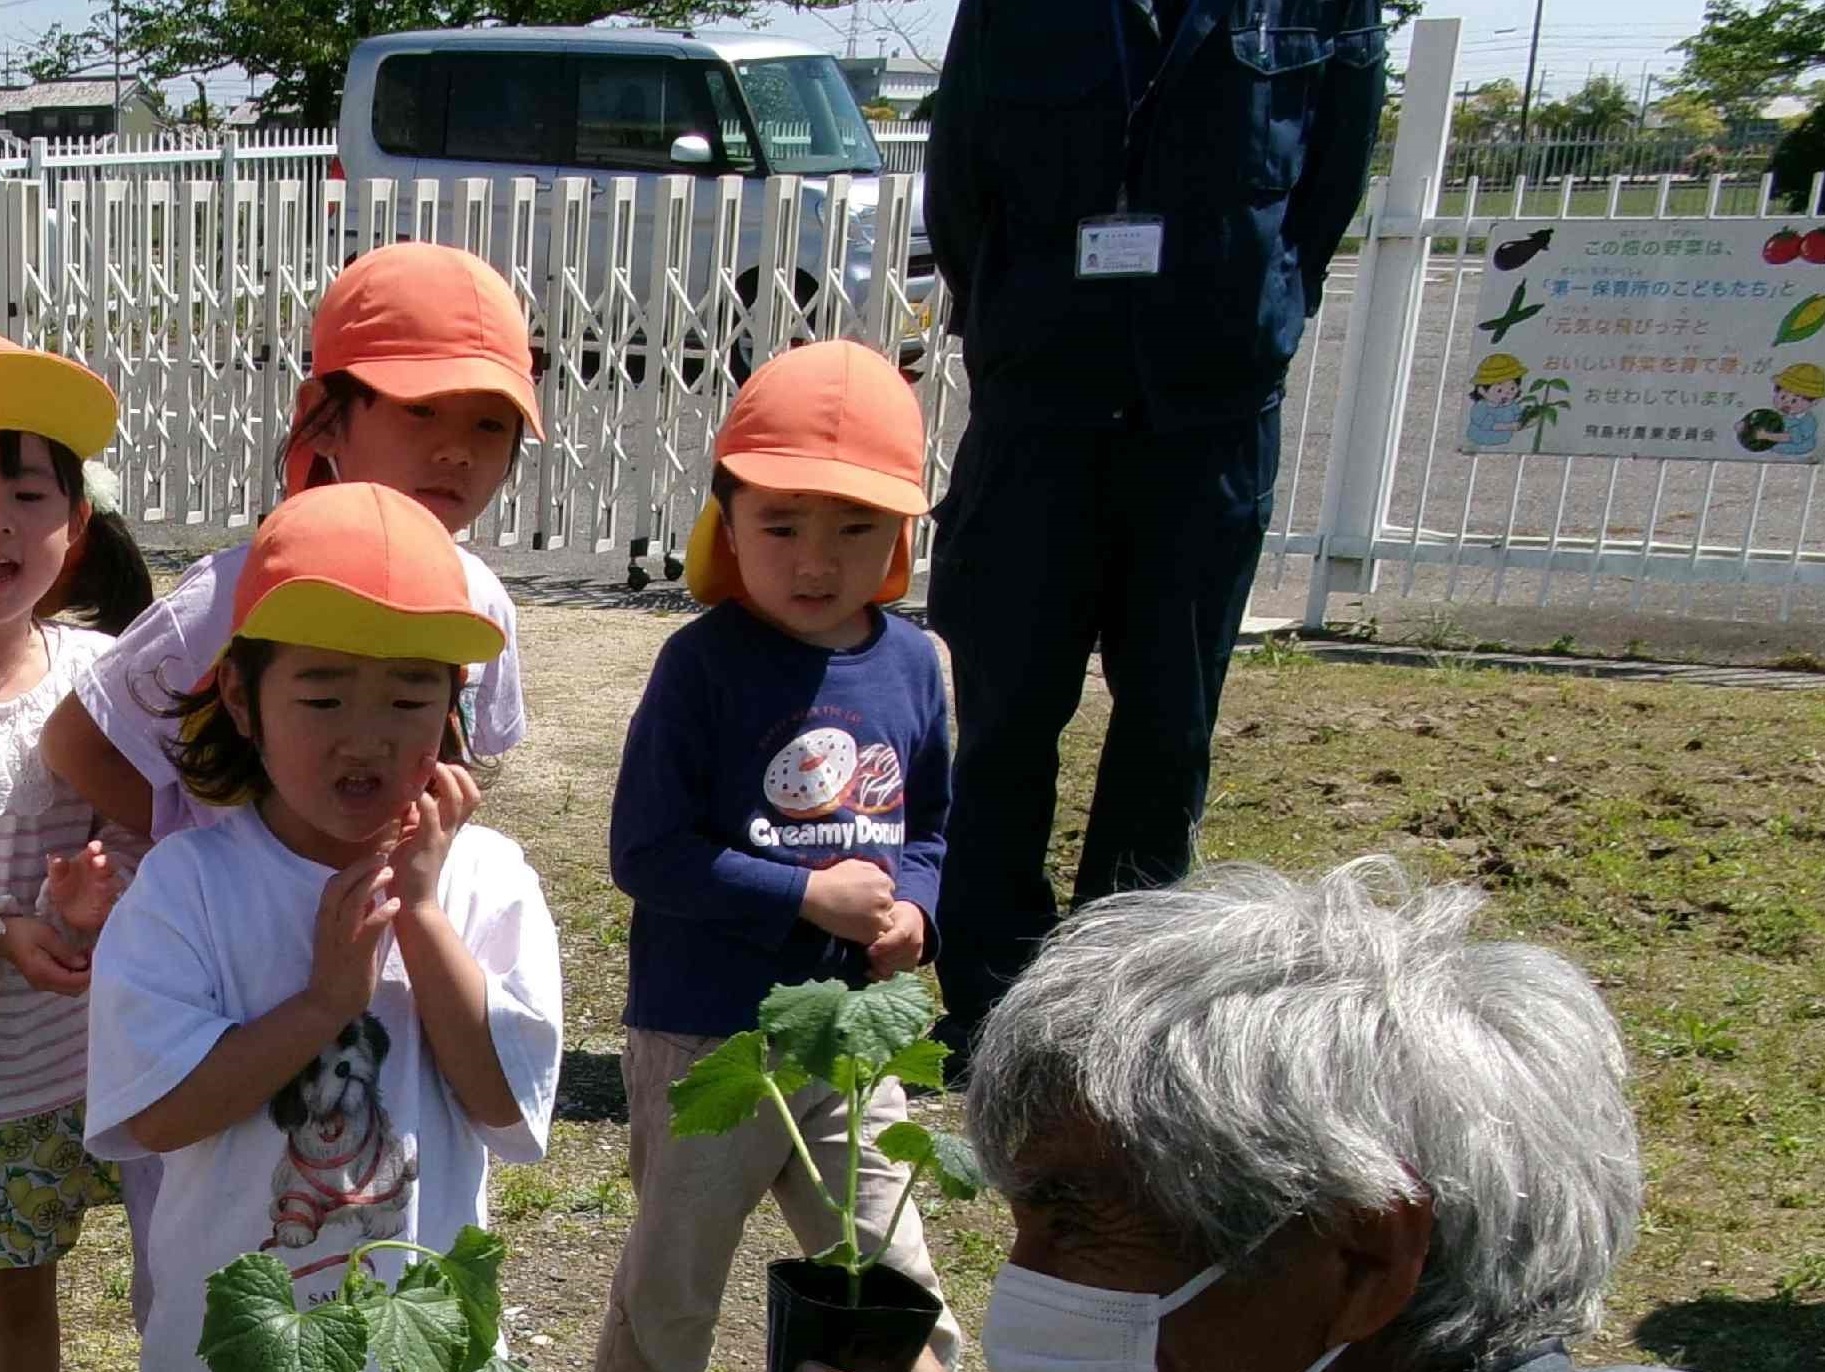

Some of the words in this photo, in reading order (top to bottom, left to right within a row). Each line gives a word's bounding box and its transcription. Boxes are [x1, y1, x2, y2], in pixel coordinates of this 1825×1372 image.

[1584, 387, 1744, 408] おせわしています。
[749, 818, 854, 850] Creamy
